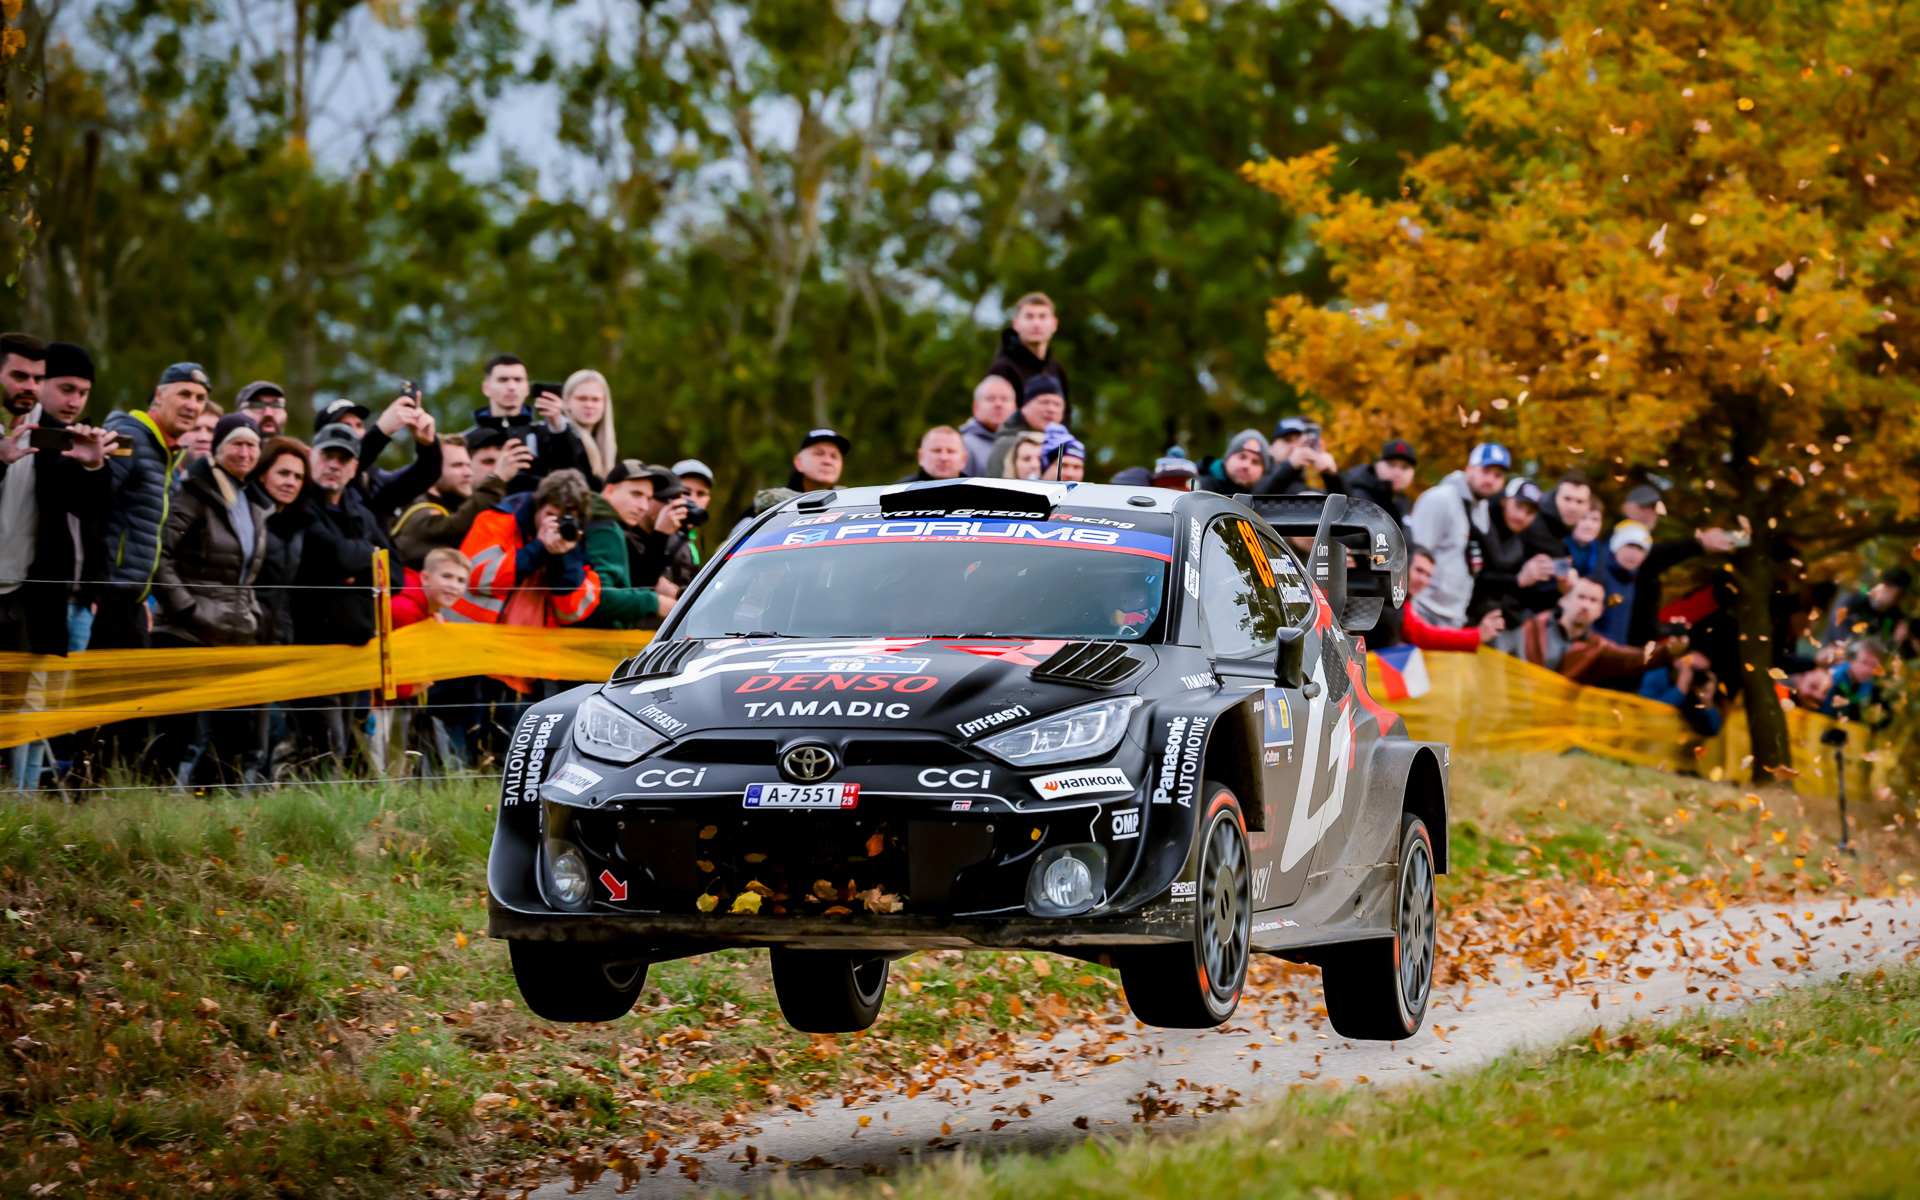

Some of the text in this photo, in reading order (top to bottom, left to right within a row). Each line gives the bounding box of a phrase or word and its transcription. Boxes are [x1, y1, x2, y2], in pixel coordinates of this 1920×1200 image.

[848, 510, 945, 521] TOYOTA
[951, 508, 1045, 518] GAZOO
[1049, 513, 1136, 529] Racing
[834, 521, 1120, 545] FORUM8
[1236, 520, 1276, 588] 69
[828, 662, 866, 672] 69
[734, 674, 939, 694] DENSO
[1180, 671, 1216, 690] TAMADIC
[744, 701, 911, 719] TAMADIC
[503, 714, 541, 807] AUTOMOTIVE
[523, 713, 565, 802] Panasonic
[1152, 716, 1189, 804] Panasonic
[1176, 716, 1209, 808] AUTOMOTIVE
[767, 787, 835, 803] A-7551
[844, 785, 856, 794] 11
[841, 796, 855, 806] 25
[1111, 814, 1139, 835] OMP
